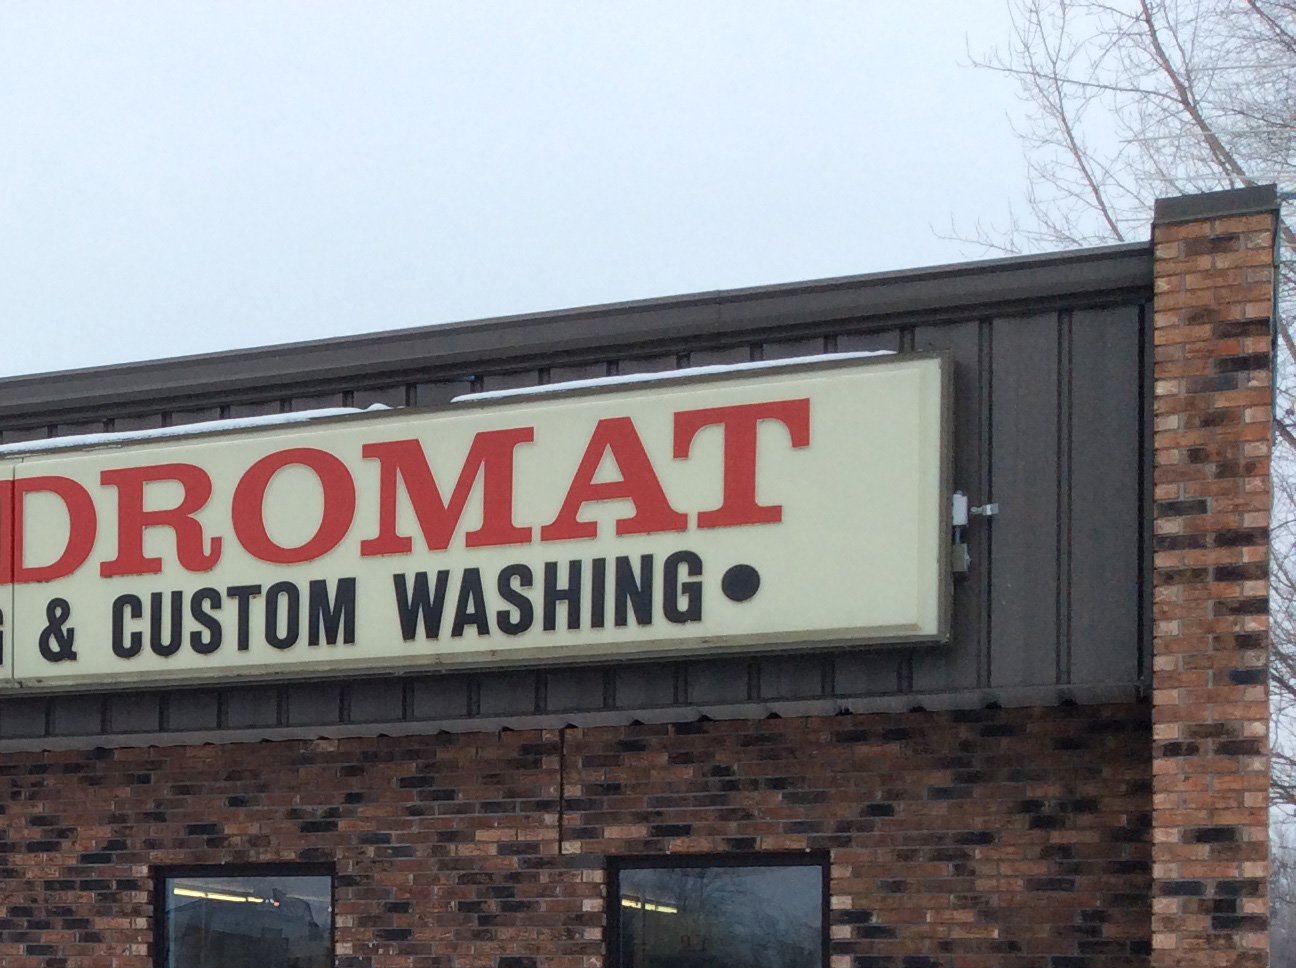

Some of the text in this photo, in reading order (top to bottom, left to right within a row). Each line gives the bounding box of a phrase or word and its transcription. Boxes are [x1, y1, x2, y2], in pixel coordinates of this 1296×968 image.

[38, 598, 78, 663] &
[111, 577, 357, 659] CUSTOM
[393, 550, 703, 641] WASHING
